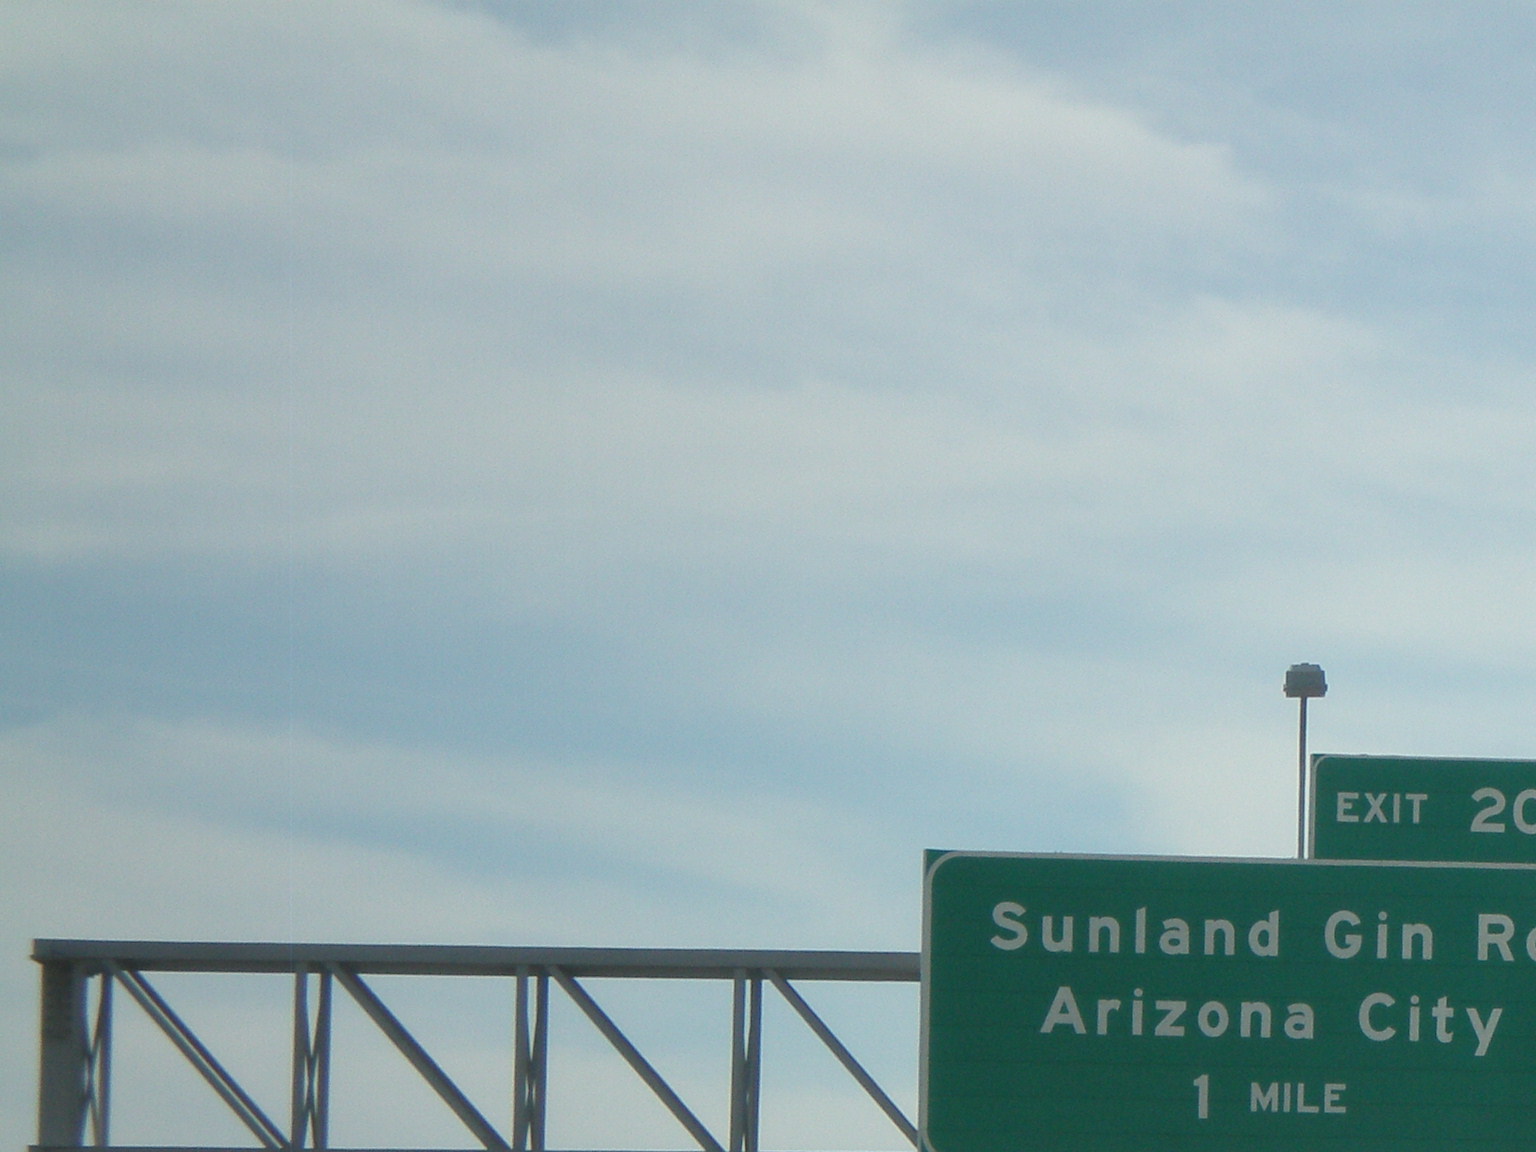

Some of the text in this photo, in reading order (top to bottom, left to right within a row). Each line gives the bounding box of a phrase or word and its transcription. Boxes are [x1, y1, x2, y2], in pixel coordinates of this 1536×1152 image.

[1336, 791, 1429, 824] EXIT
[990, 901, 1280, 957] Sunland
[1324, 909, 1434, 961] Gin
[1040, 985, 1503, 1057] Arizona City
[1193, 1073, 1347, 1119] 1 MILE
